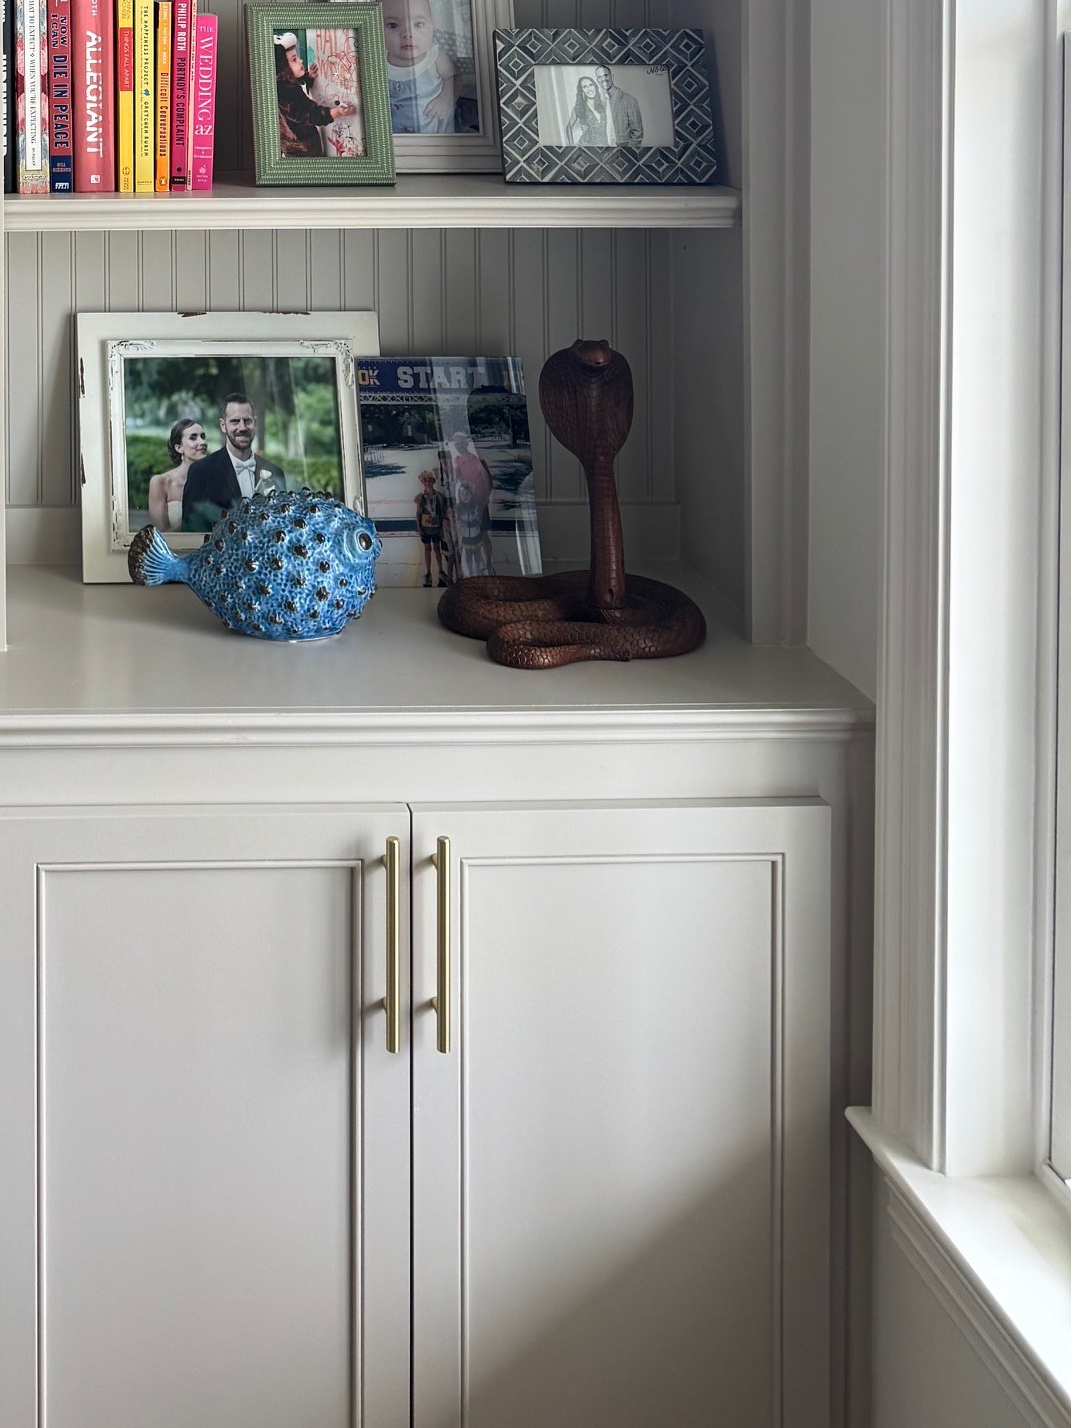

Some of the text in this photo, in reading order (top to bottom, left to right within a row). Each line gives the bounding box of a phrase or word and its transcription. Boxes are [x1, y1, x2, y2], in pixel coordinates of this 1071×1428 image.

[29, 15, 35, 24] TO
[59, 14, 67, 48] NOW
[177, 3, 187, 51] PHILIP ROTH
[52, 54, 70, 149] DIE IN PEACE
[85, 30, 103, 158] ALLEGIANT
[160, 72, 169, 157] Difficult Conversations
[175, 57, 185, 146] PORTNOY'S COMPLAINT
[196, 36, 214, 121] WEDDING
[396, 366, 485, 389] START
